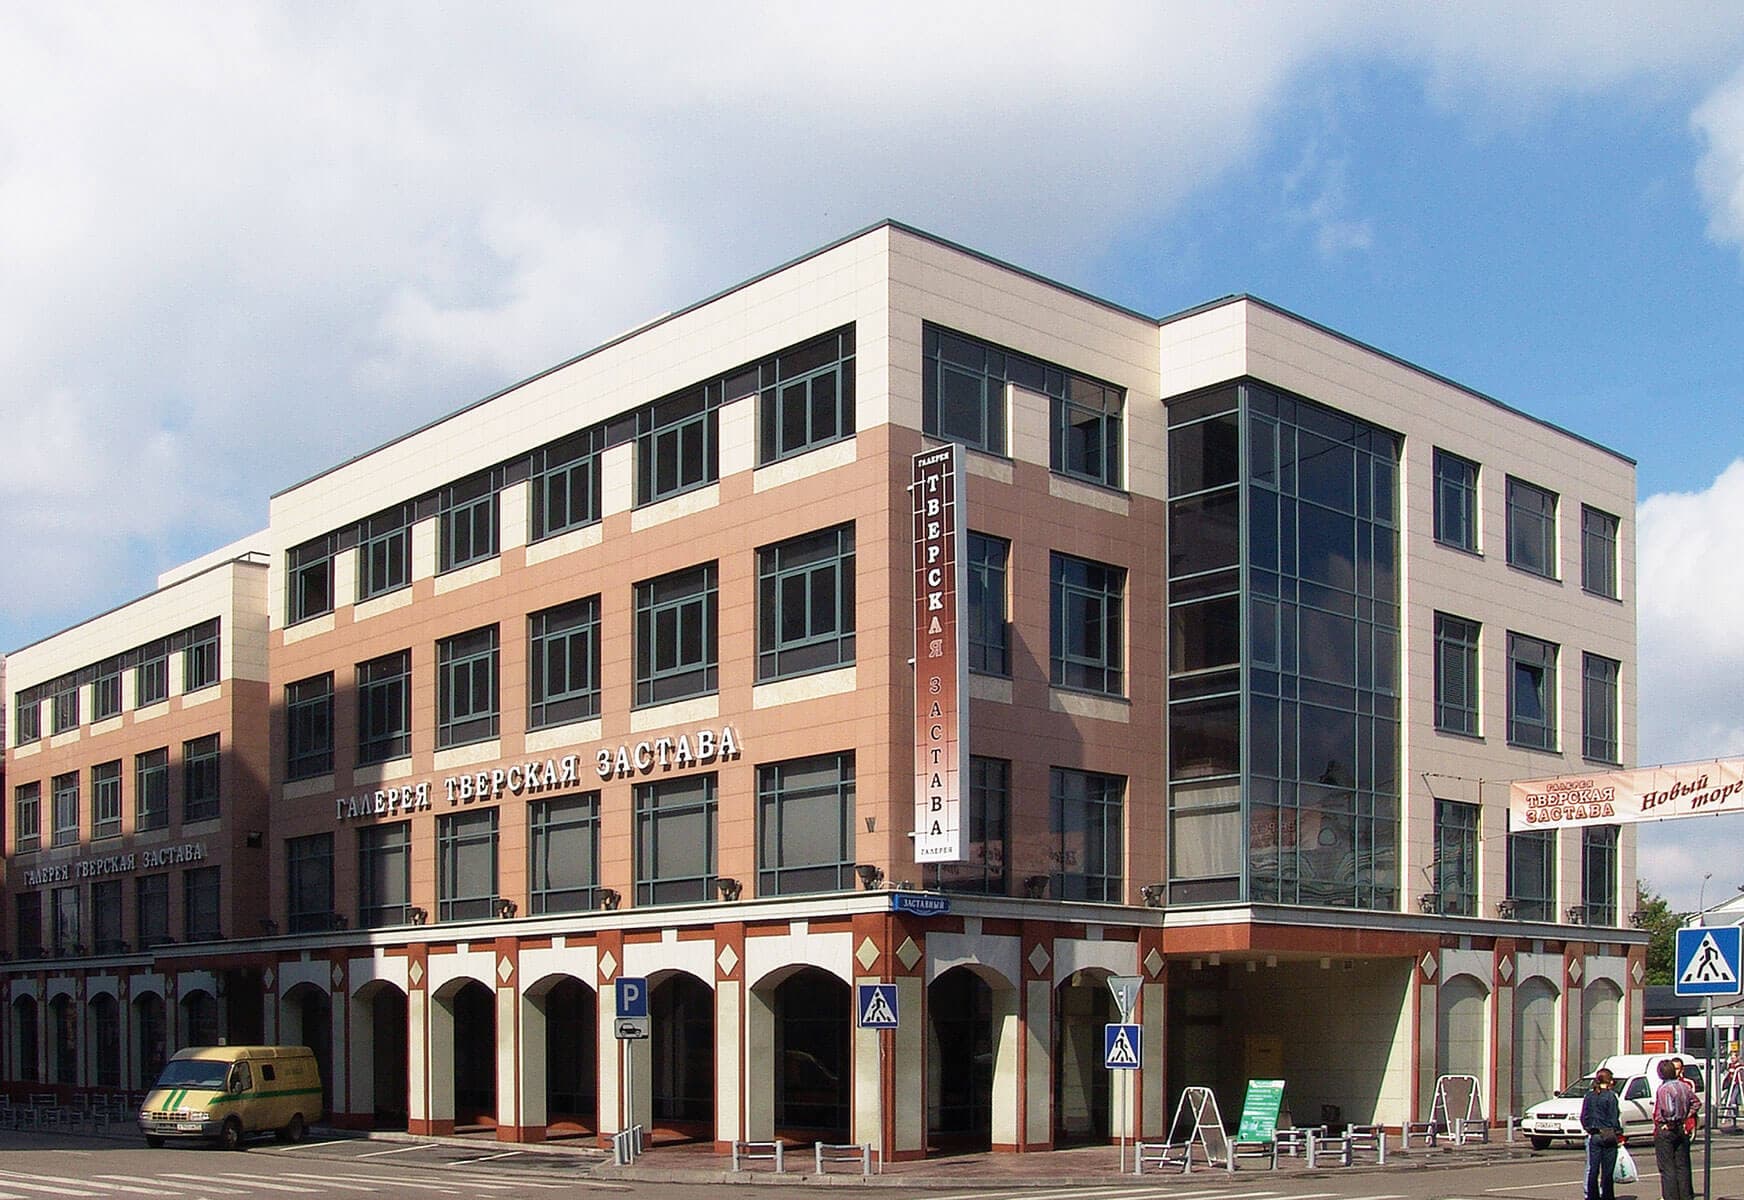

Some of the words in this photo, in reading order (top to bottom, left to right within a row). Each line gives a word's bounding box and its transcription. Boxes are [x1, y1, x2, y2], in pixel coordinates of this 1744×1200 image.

[918, 452, 949, 467] ГАЛЕРЕЯ
[927, 474, 943, 658] ТВЕРСКАЯ
[335, 782, 431, 820] ГАЛЕРЕЯ
[444, 755, 580, 802] ТВЕРСКАЯ
[596, 725, 738, 778] ЗАСТАВА
[929, 676, 943, 836] ЗАСТАВА
[1527, 787, 1615, 808] ТВЕРСКАЯ
[1641, 774, 1709, 812] Новый
[1527, 803, 1615, 823] ЗАСТАВА
[23, 864, 69, 886] ГАЛЕРЕЯ
[75, 853, 135, 880] ТВЕРСКАЯ
[144, 843, 202, 868] ЗАСТАВА
[623, 983, 640, 1011] P
